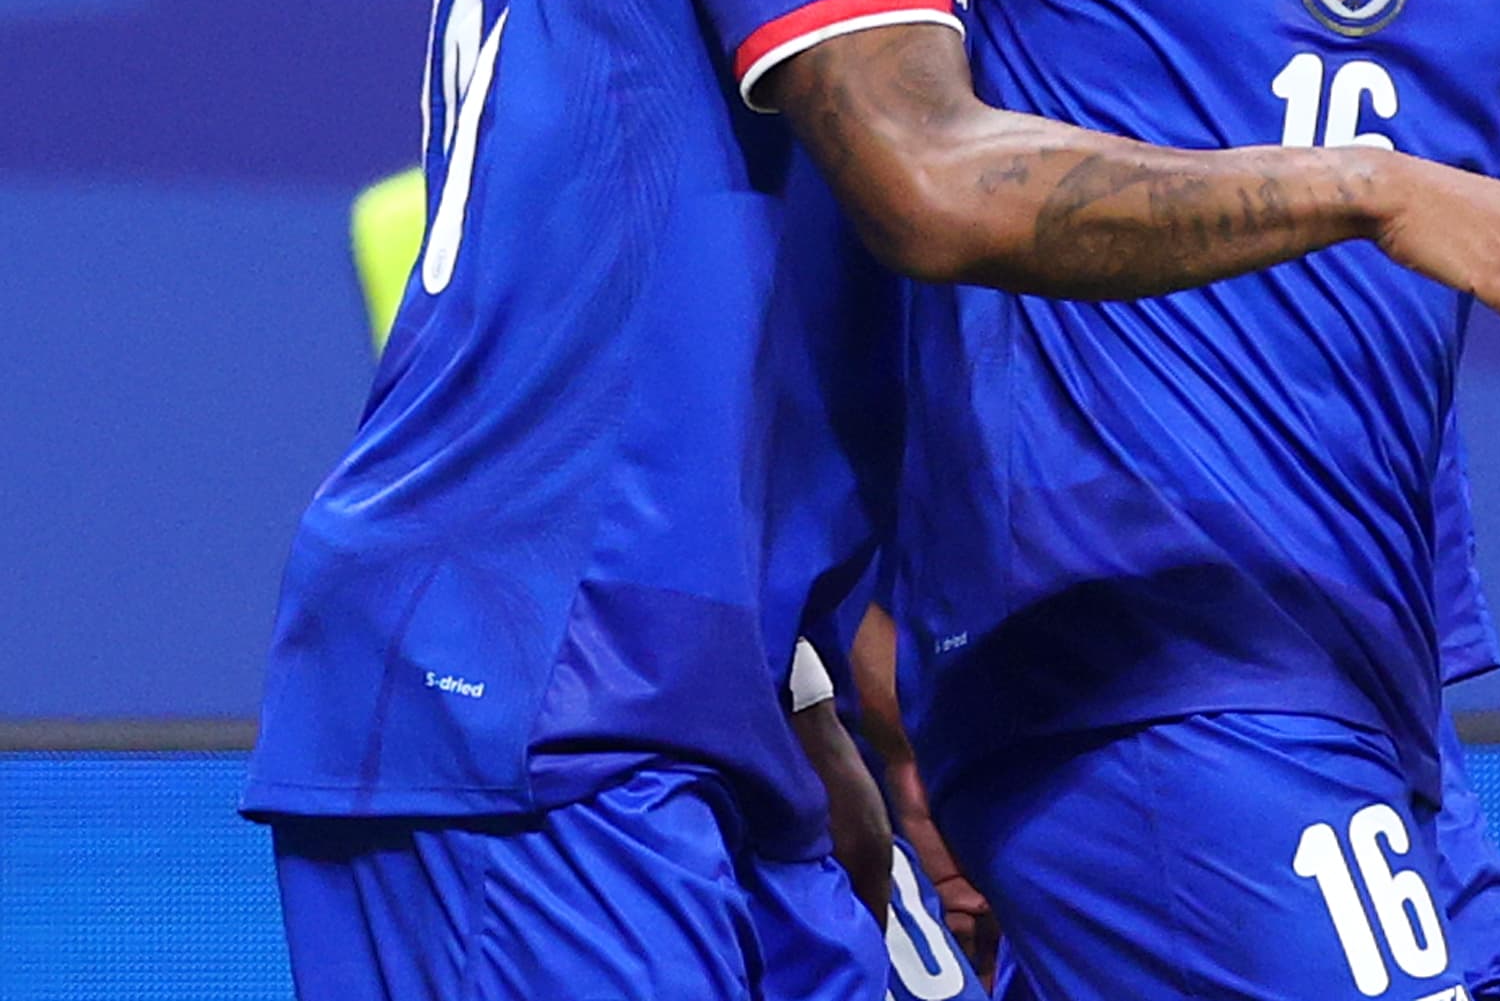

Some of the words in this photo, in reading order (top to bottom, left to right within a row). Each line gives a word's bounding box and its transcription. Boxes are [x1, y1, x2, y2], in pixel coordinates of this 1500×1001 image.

[1272, 53, 1397, 149] 16
[424, 671, 485, 698] S-dried
[1293, 803, 1448, 997] 16
